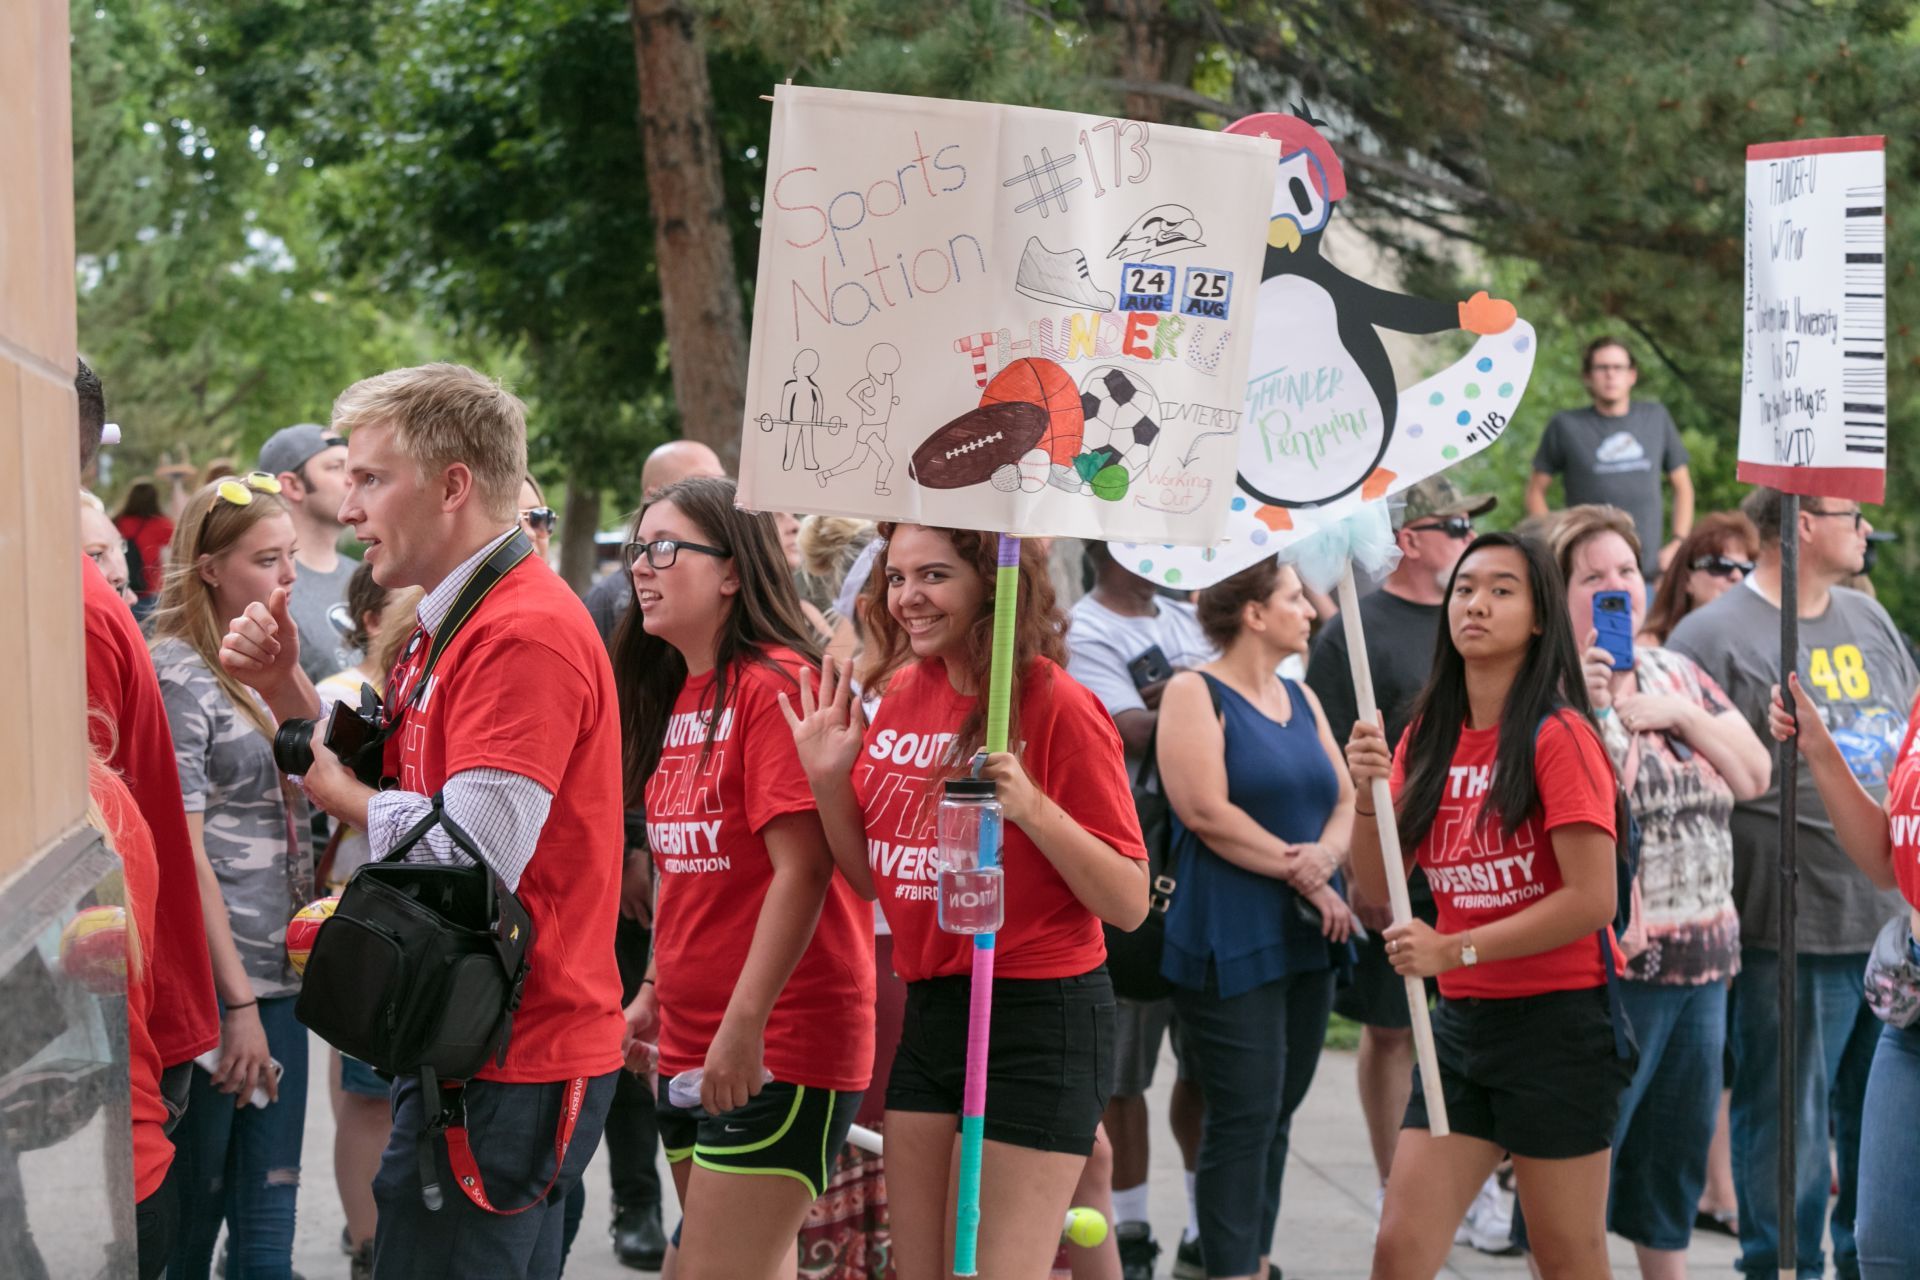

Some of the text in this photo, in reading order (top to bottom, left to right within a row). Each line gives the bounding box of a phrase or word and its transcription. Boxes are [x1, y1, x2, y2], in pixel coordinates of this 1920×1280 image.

[1002, 119, 1152, 219] #173
[773, 131, 967, 267] Sports
[792, 234, 985, 342] Nation
[1124, 296, 1164, 310] AUG
[1131, 269, 1165, 293] 24
[1187, 301, 1224, 316] AUG
[1193, 274, 1226, 297] 25
[953, 311, 1232, 388] THUNDER U
[1246, 366, 1344, 424] THUNDER
[1258, 408, 1368, 470] Penguins
[1810, 644, 1871, 700] 48
[569, 1076, 584, 1123] NIVERSITY
